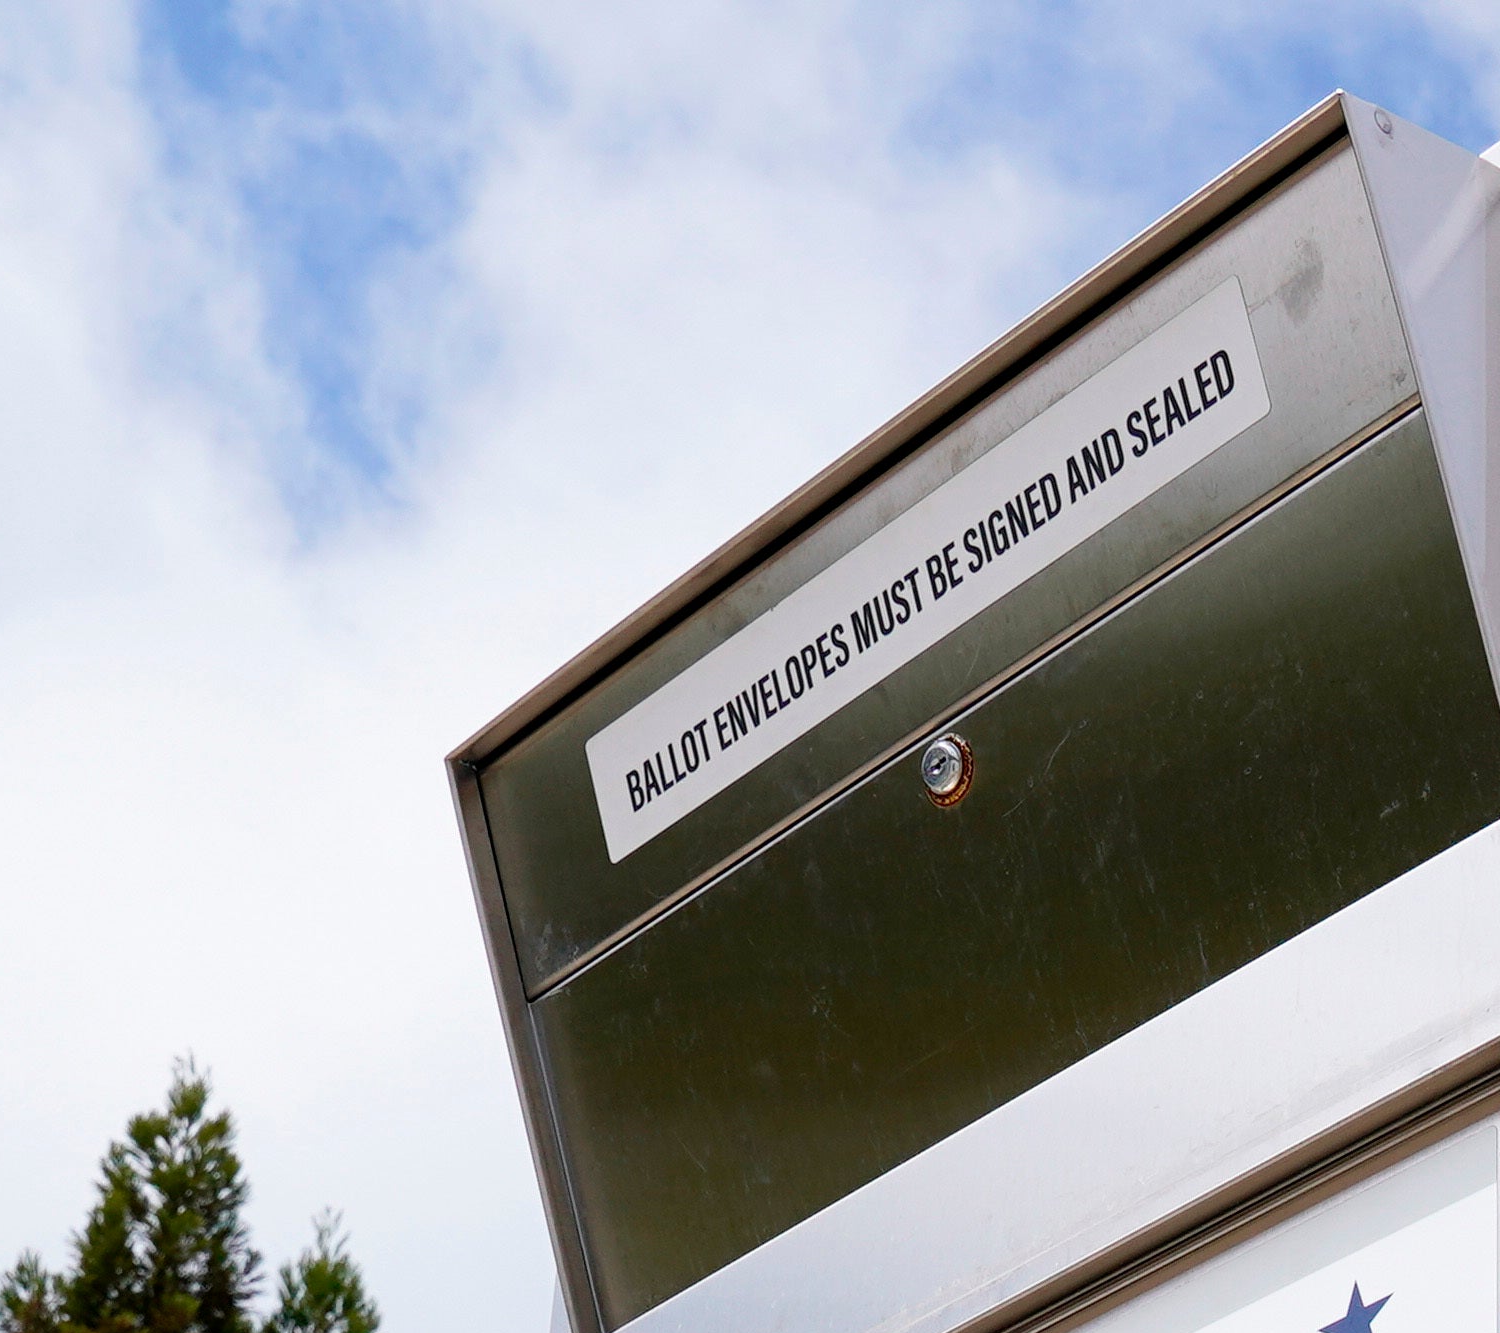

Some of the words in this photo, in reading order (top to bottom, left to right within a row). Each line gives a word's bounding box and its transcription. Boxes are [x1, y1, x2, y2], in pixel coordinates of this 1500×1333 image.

[625, 718, 711, 813] BALLOT
[712, 623, 850, 751] ENVELOPES
[850, 567, 923, 654] MUST
[925, 541, 964, 601] BE
[963, 473, 1062, 574] SIGNED
[1066, 432, 1125, 505] AND
[1126, 349, 1235, 458] SEALED
